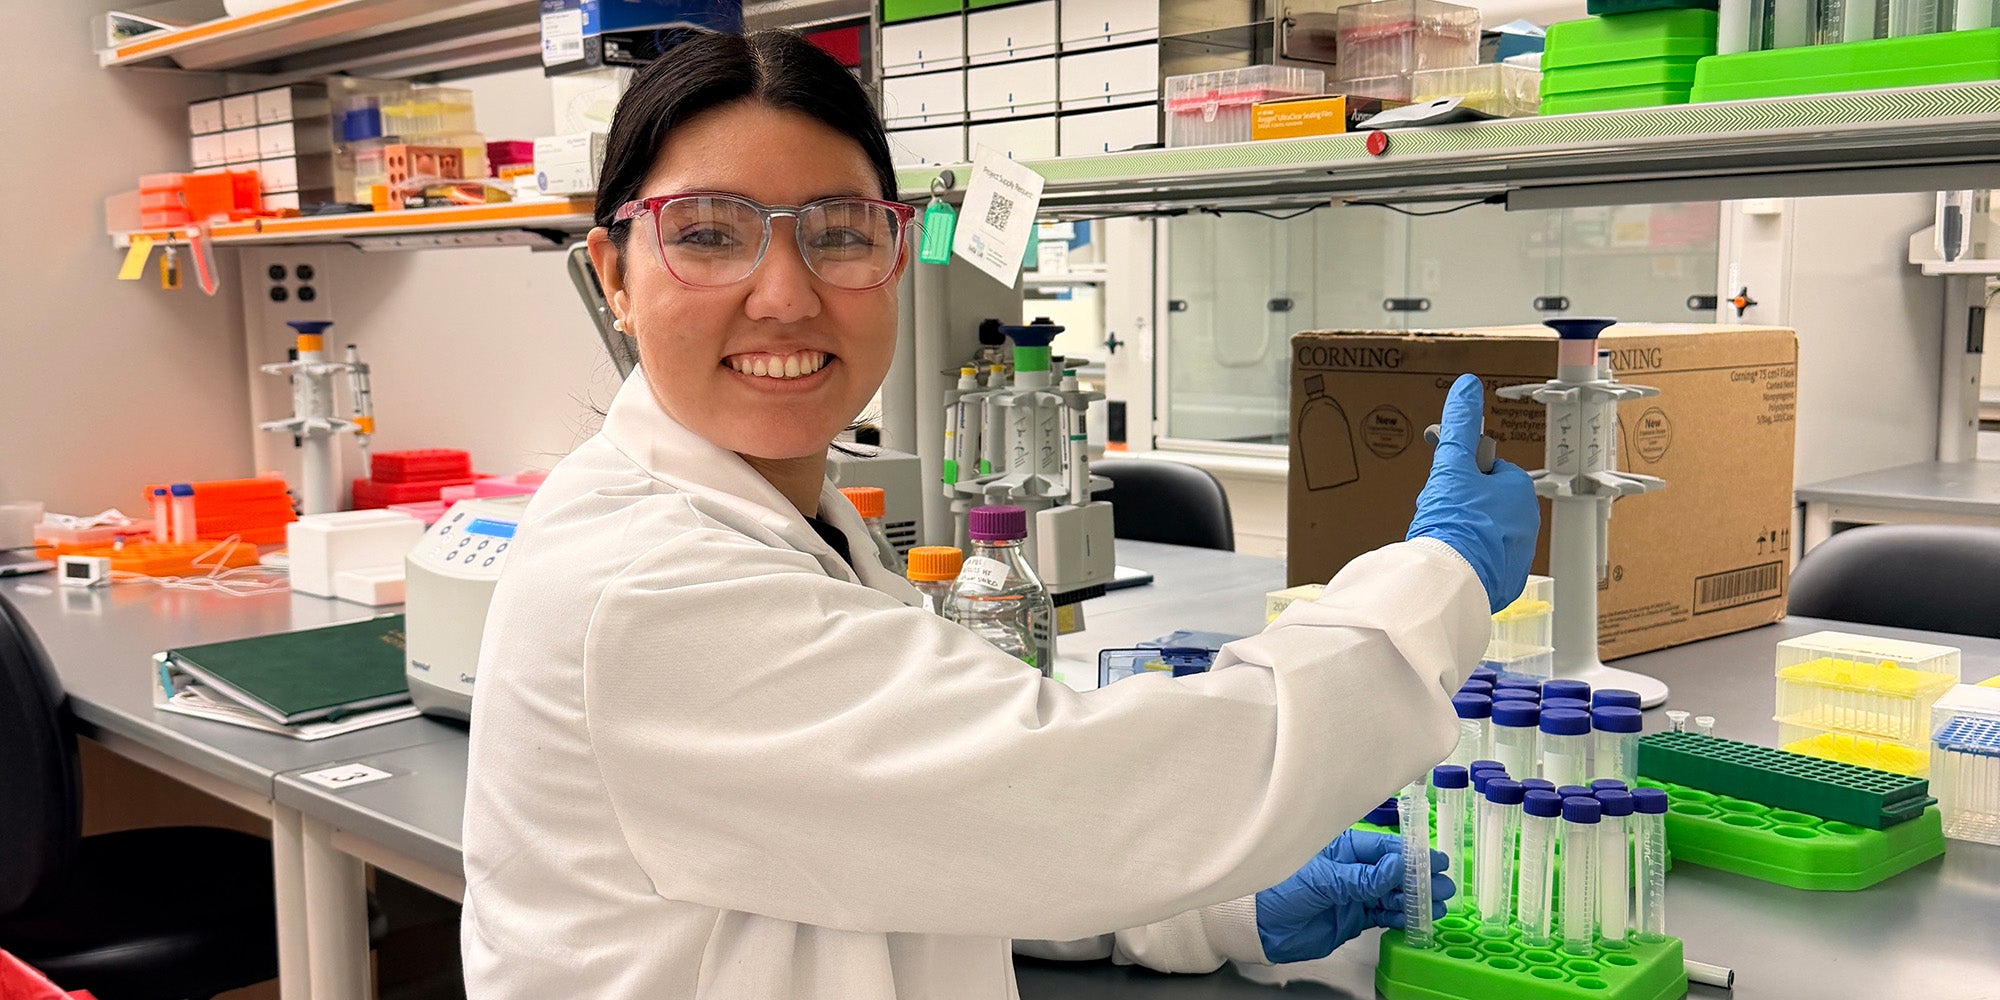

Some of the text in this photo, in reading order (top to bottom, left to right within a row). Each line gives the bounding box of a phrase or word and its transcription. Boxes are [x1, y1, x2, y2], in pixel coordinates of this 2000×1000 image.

[1298, 345, 1401, 369] CORNING
[1609, 347, 1662, 371] RNING
[1375, 413, 1397, 426] New
[1645, 418, 1661, 429] New
